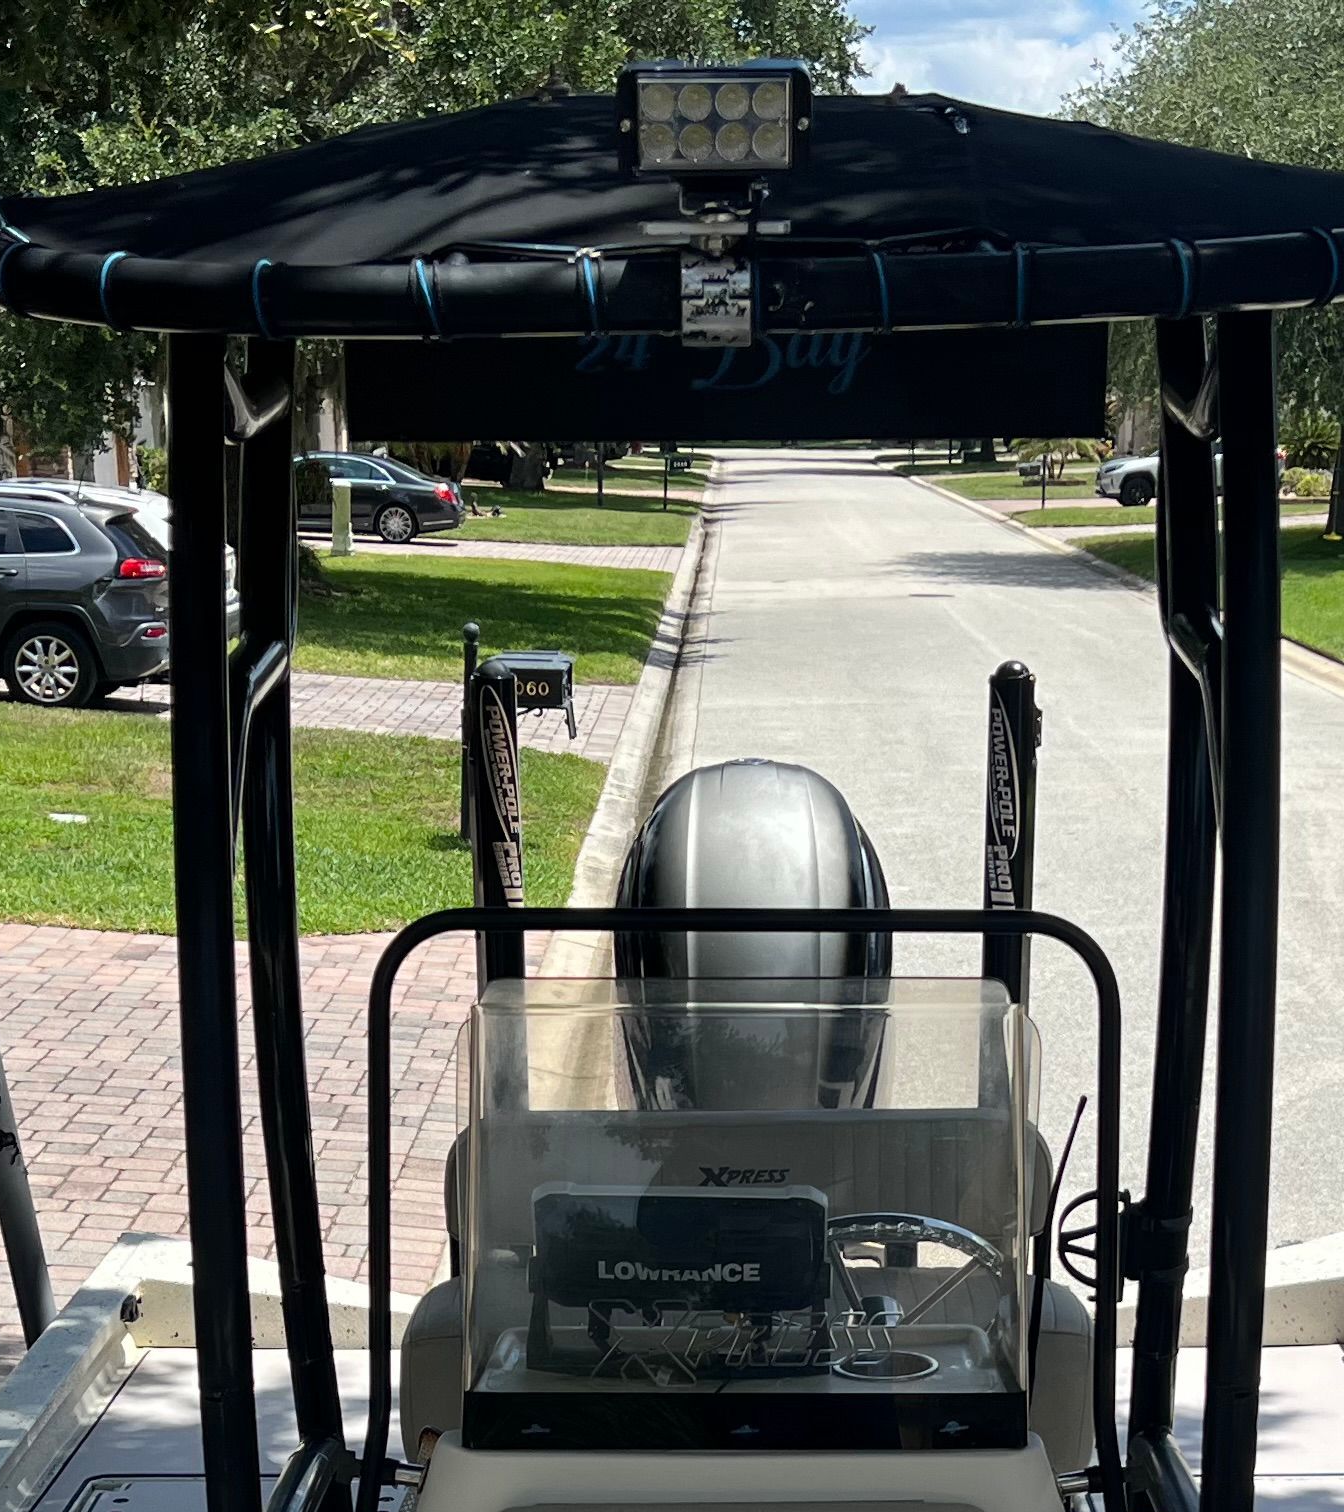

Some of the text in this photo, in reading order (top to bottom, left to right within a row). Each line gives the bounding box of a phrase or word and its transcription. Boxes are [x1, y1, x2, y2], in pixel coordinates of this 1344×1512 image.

[485, 705, 519, 834] POWER-POLE
[991, 707, 1016, 838] POWER-POLE
[503, 841, 522, 888] PRO
[994, 844, 1012, 890] PRO
[698, 1166, 791, 1187] XPRESS
[597, 1259, 761, 1283] LOWRANCE
[588, 1299, 905, 1387] XPRESS
